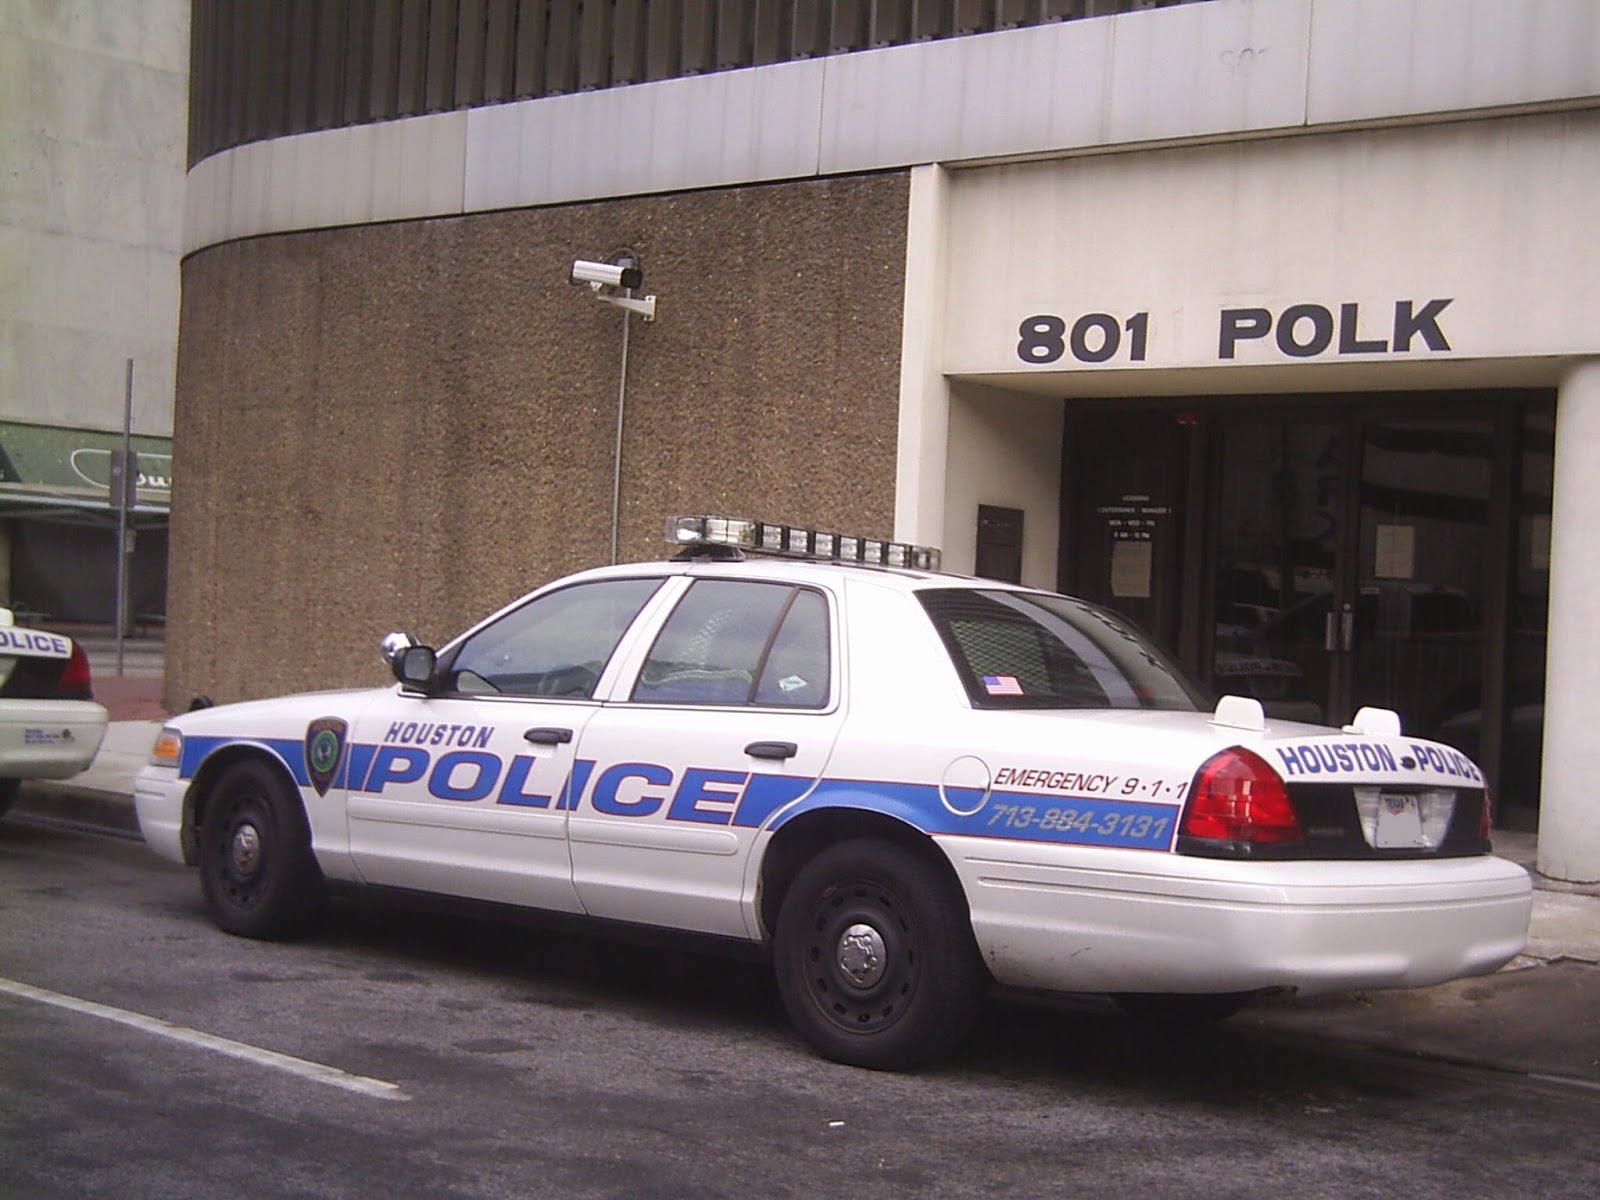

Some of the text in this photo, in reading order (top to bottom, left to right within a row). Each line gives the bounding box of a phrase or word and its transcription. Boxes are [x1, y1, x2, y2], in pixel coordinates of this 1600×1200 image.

[1017, 297, 1455, 364] 801 POLK
[384, 721, 496, 749] HOUSTON
[993, 767, 1119, 794] EMERGENCY
[1276, 743, 1481, 782] HOUSTON POLICE
[364, 744, 749, 825] POLICE
[986, 802, 1170, 840] 713-884-3131
